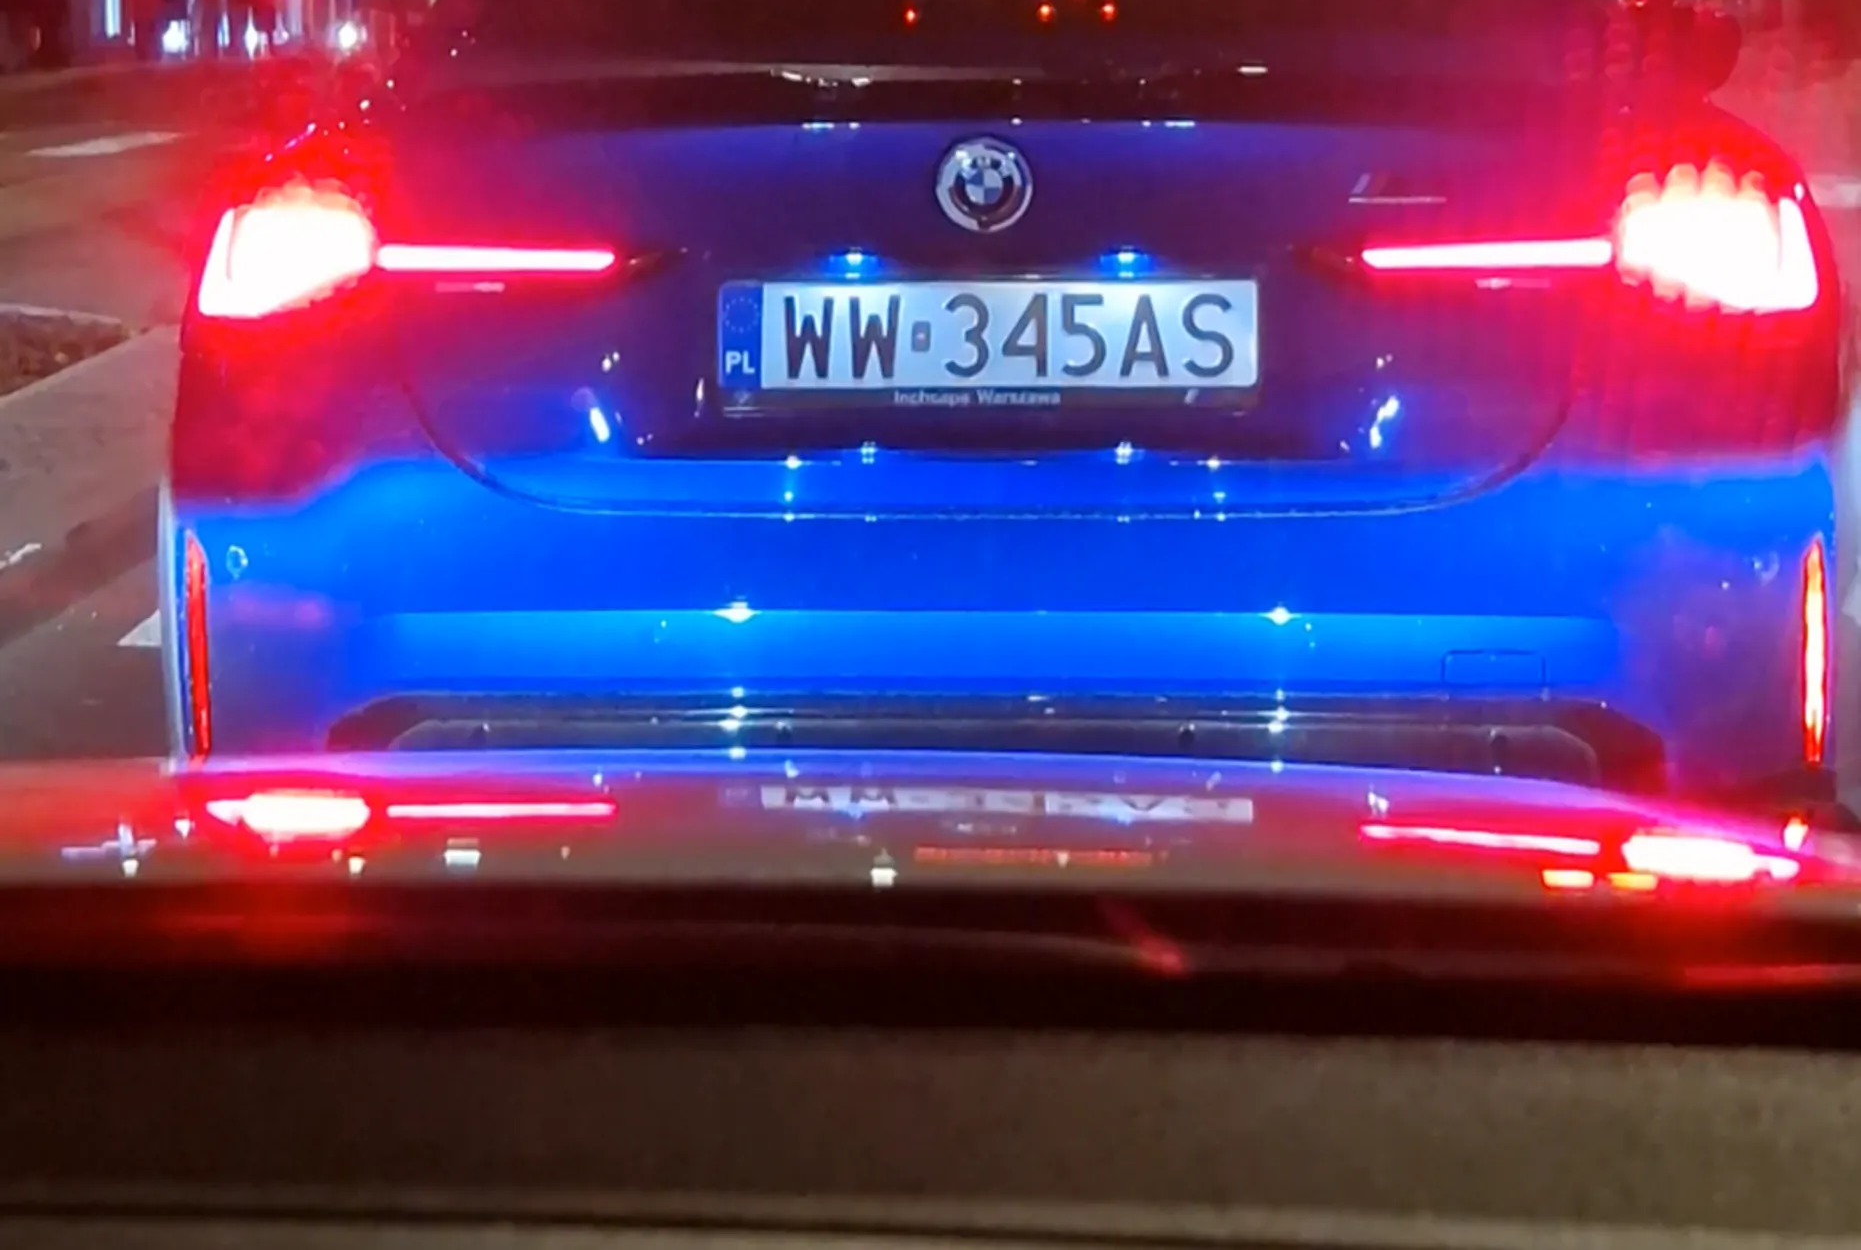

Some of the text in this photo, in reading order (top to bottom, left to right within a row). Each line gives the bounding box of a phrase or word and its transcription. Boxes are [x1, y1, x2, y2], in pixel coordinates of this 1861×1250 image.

[784, 292, 1234, 380] WW 345AS
[725, 350, 755, 375] PL
[976, 389, 1062, 405] Warszawa
